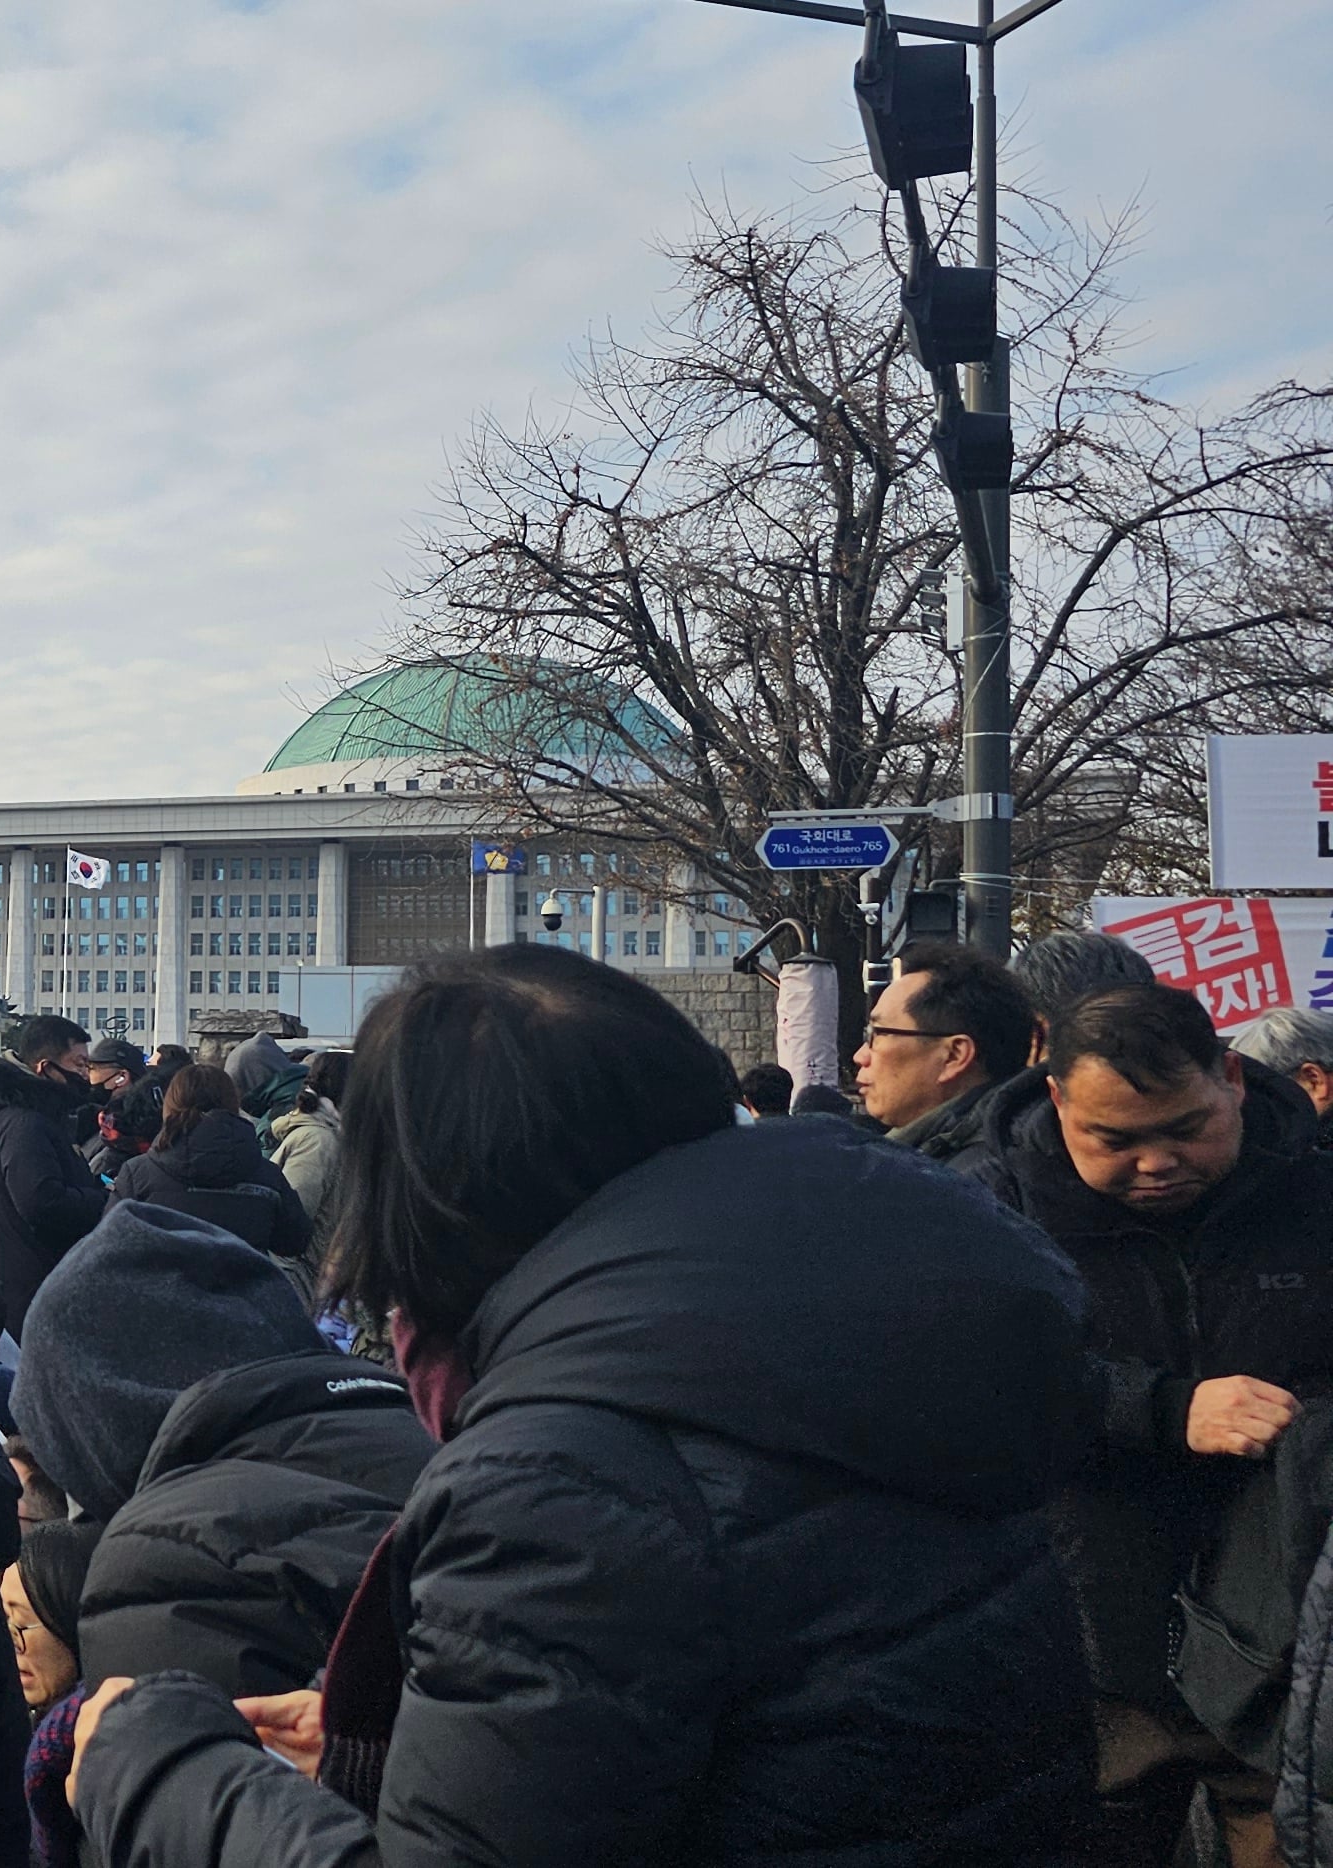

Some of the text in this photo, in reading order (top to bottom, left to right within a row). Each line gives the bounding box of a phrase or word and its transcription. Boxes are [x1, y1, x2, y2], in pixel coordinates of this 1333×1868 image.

[799, 829, 854, 844] 국회대로
[771, 843, 791, 854] 761
[792, 845, 862, 855] Gukhoe-daero
[862, 840, 883, 852] 765
[1118, 897, 1260, 981] 특검
